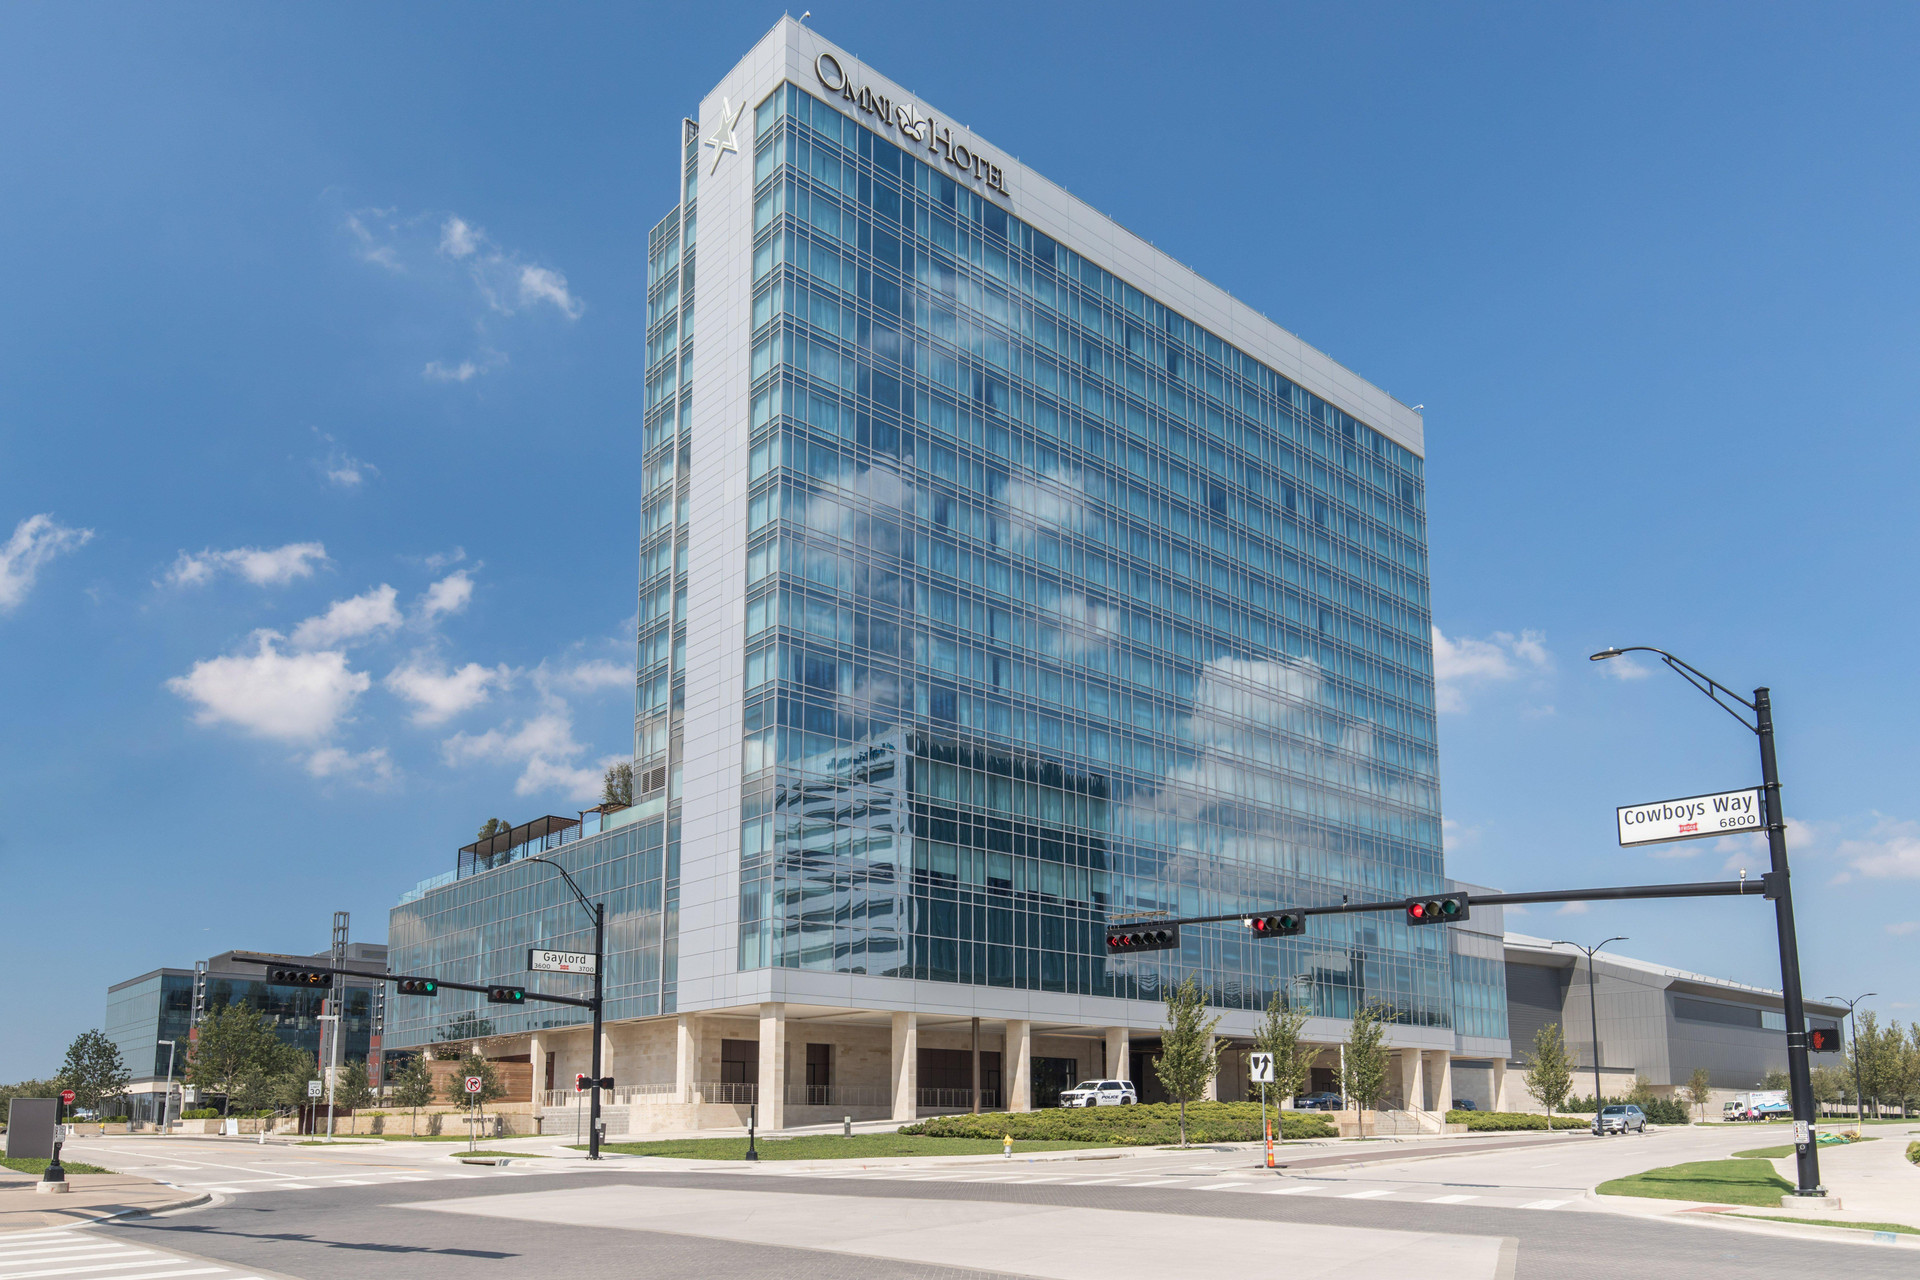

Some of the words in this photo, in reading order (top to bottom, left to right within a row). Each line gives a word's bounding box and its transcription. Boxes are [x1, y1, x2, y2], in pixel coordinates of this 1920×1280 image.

[815, 53, 893, 127] OMNI
[928, 117, 1010, 197] HOTEL
[1624, 803, 1705, 825] Cowboys
[1713, 796, 1752, 813] Way
[1720, 815, 1756, 828] 6800
[543, 952, 586, 965] Gaylord
